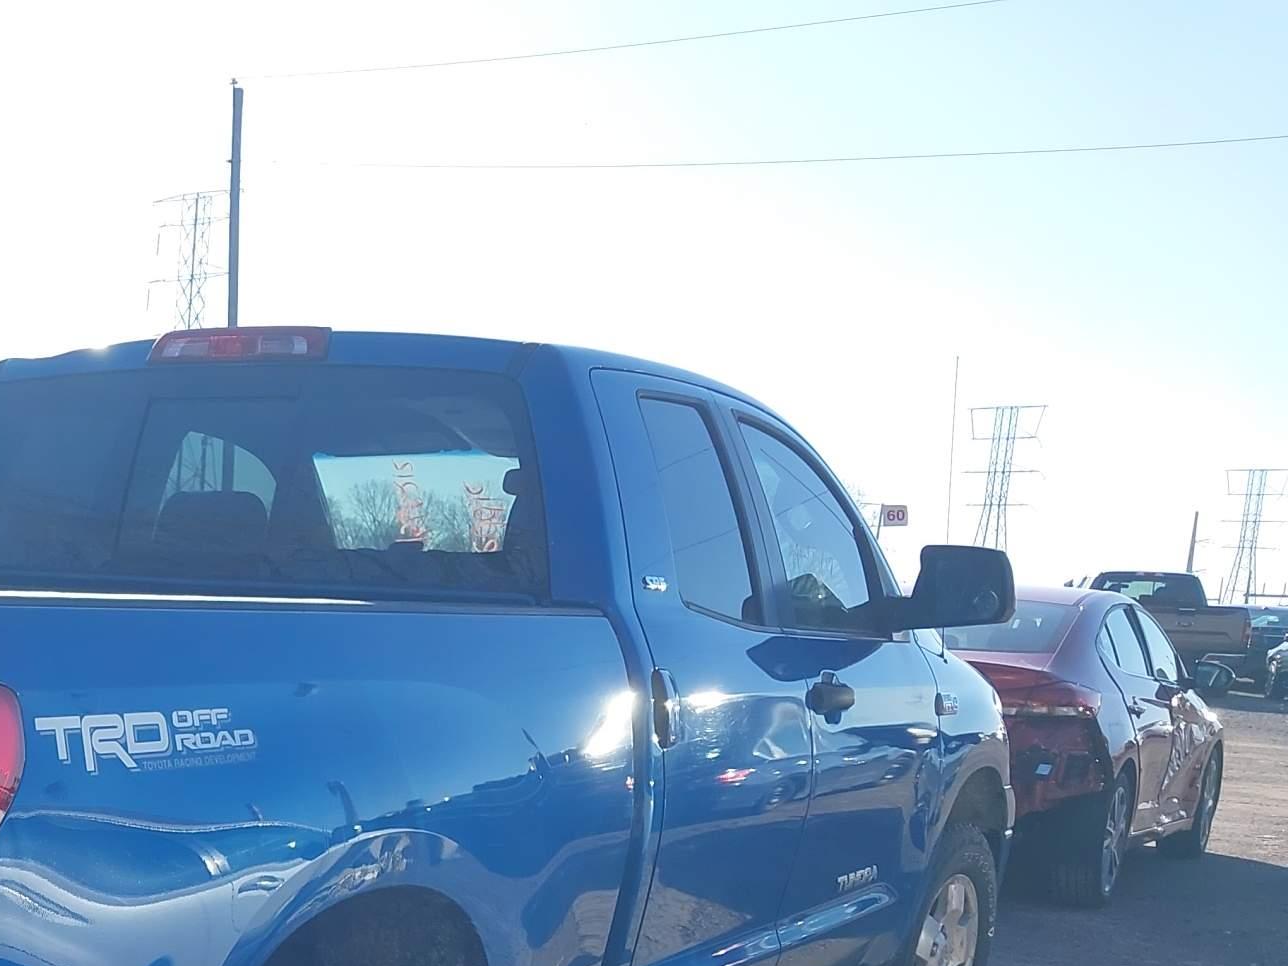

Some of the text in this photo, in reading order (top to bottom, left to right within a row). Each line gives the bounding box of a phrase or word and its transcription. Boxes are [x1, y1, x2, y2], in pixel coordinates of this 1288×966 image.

[887, 510, 905, 521] 60
[34, 708, 230, 774] TRD OFF
[174, 729, 256, 752] ROAD
